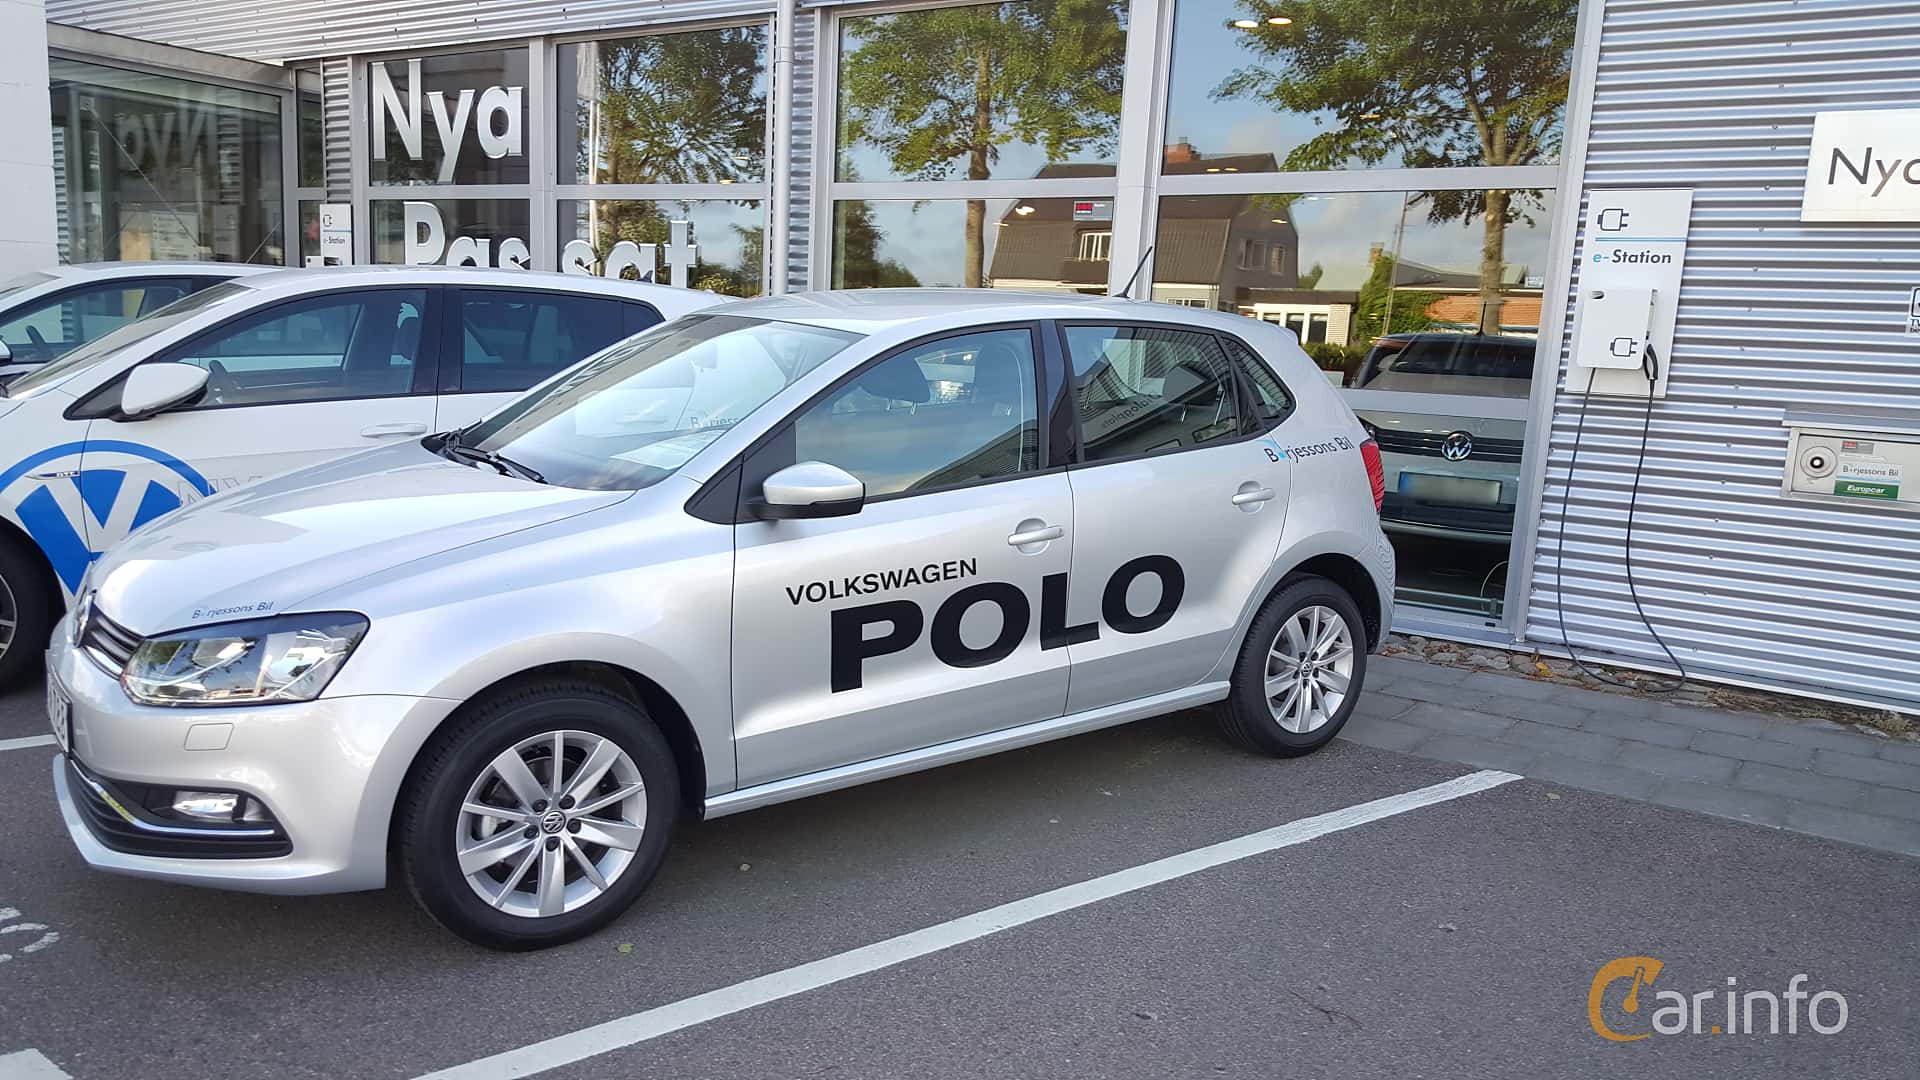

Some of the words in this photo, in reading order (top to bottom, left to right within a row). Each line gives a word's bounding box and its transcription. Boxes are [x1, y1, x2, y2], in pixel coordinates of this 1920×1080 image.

[372, 58, 523, 184] Nya
[1592, 248, 1672, 264] e-Station
[1334, 436, 1355, 450] Bil
[1888, 468, 1899, 477] Bil
[1846, 484, 1886, 495] Europcar
[786, 557, 978, 606] VOLKSWAGEN
[256, 601, 274, 611] Bil
[830, 554, 1186, 694] POLO
